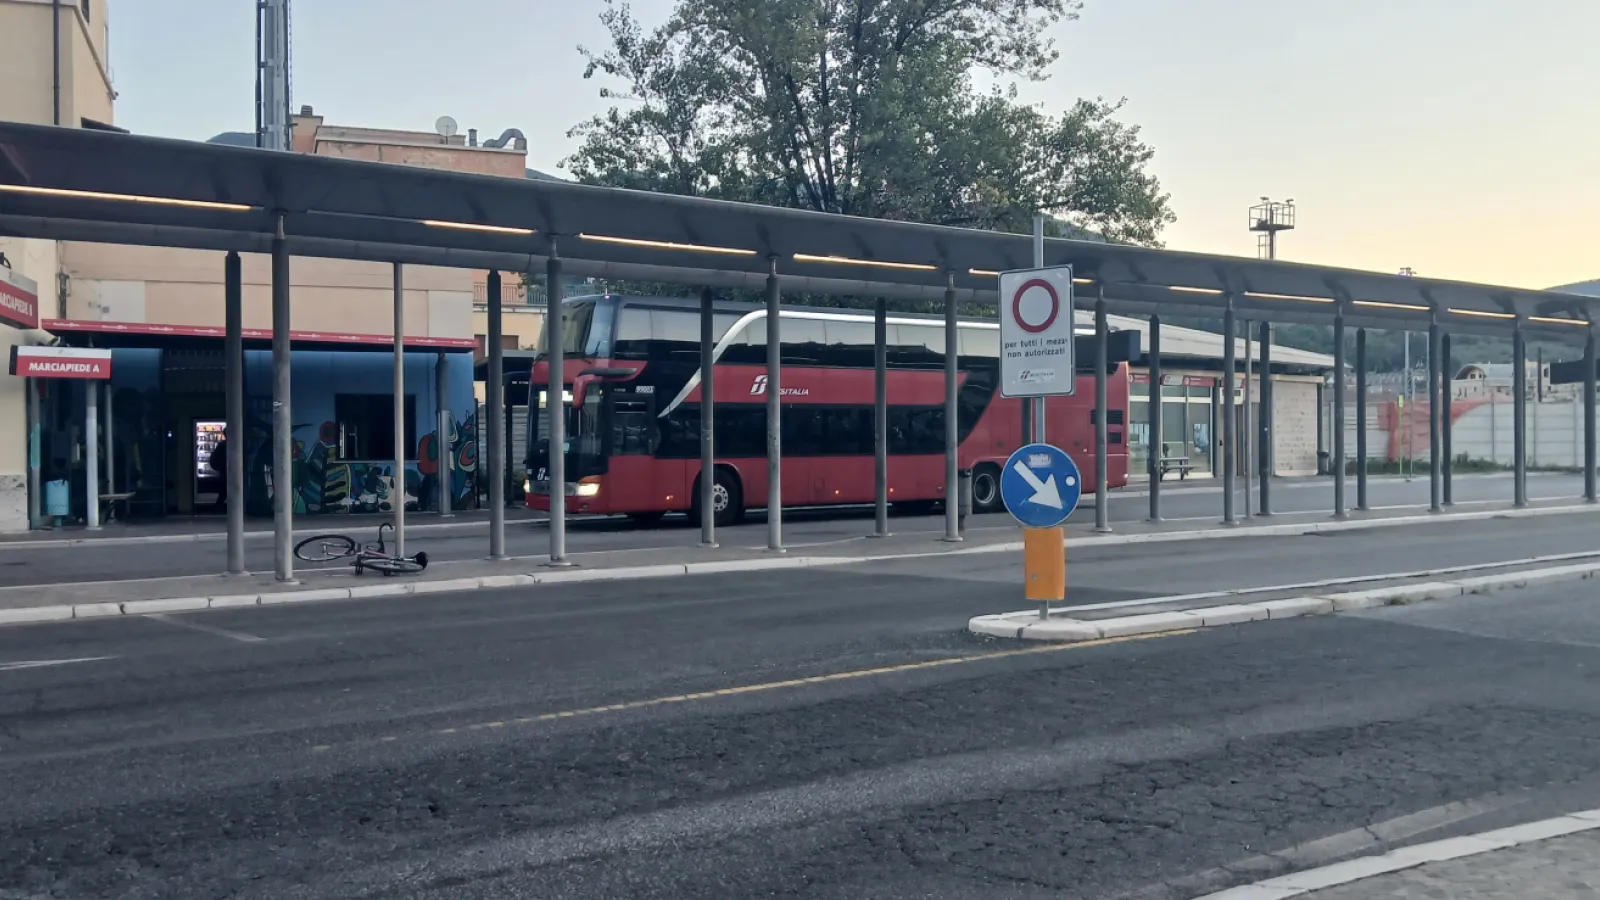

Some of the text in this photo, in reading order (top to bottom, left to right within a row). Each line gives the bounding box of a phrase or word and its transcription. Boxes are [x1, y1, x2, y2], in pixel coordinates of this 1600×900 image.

[1004, 342, 1017, 350] per
[1020, 339, 1037, 347] tutti
[1024, 347, 1066, 357] autorizzati
[28, 362, 100, 373] MARCIAPIEDE A
